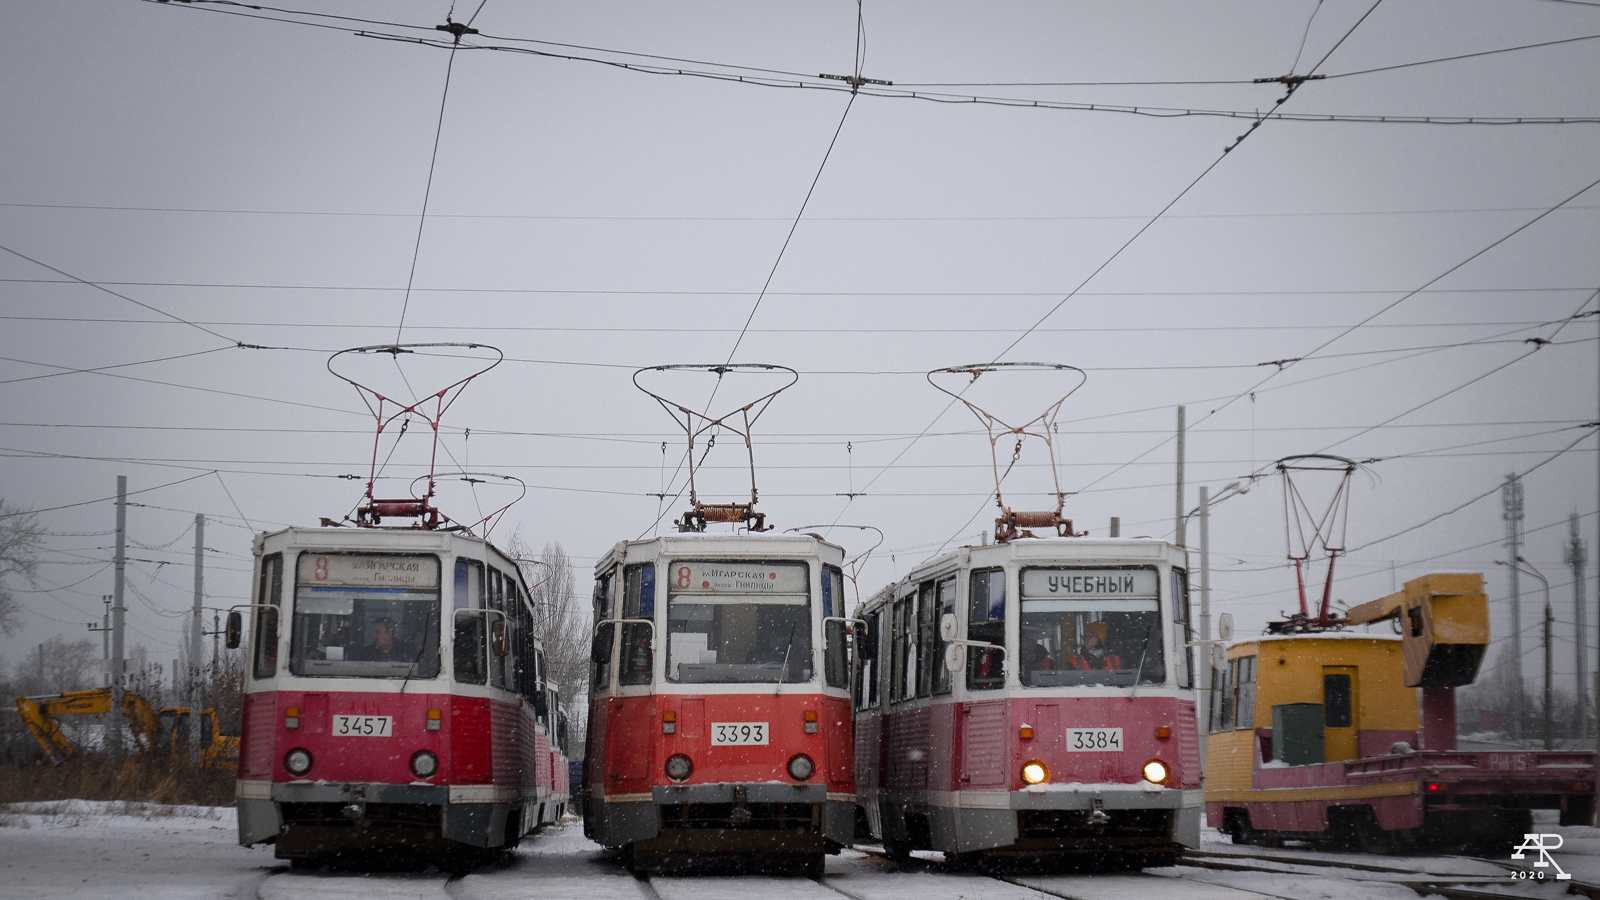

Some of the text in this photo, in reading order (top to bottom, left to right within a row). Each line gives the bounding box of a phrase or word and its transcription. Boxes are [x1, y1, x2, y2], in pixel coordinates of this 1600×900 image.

[316, 556, 329, 580] 8
[677, 567, 692, 588] 8
[1048, 574, 1134, 593] УЧЕБНЫЙ
[339, 717, 387, 735] 3457
[716, 725, 763, 742] 3393
[1073, 731, 1119, 749] 3384
